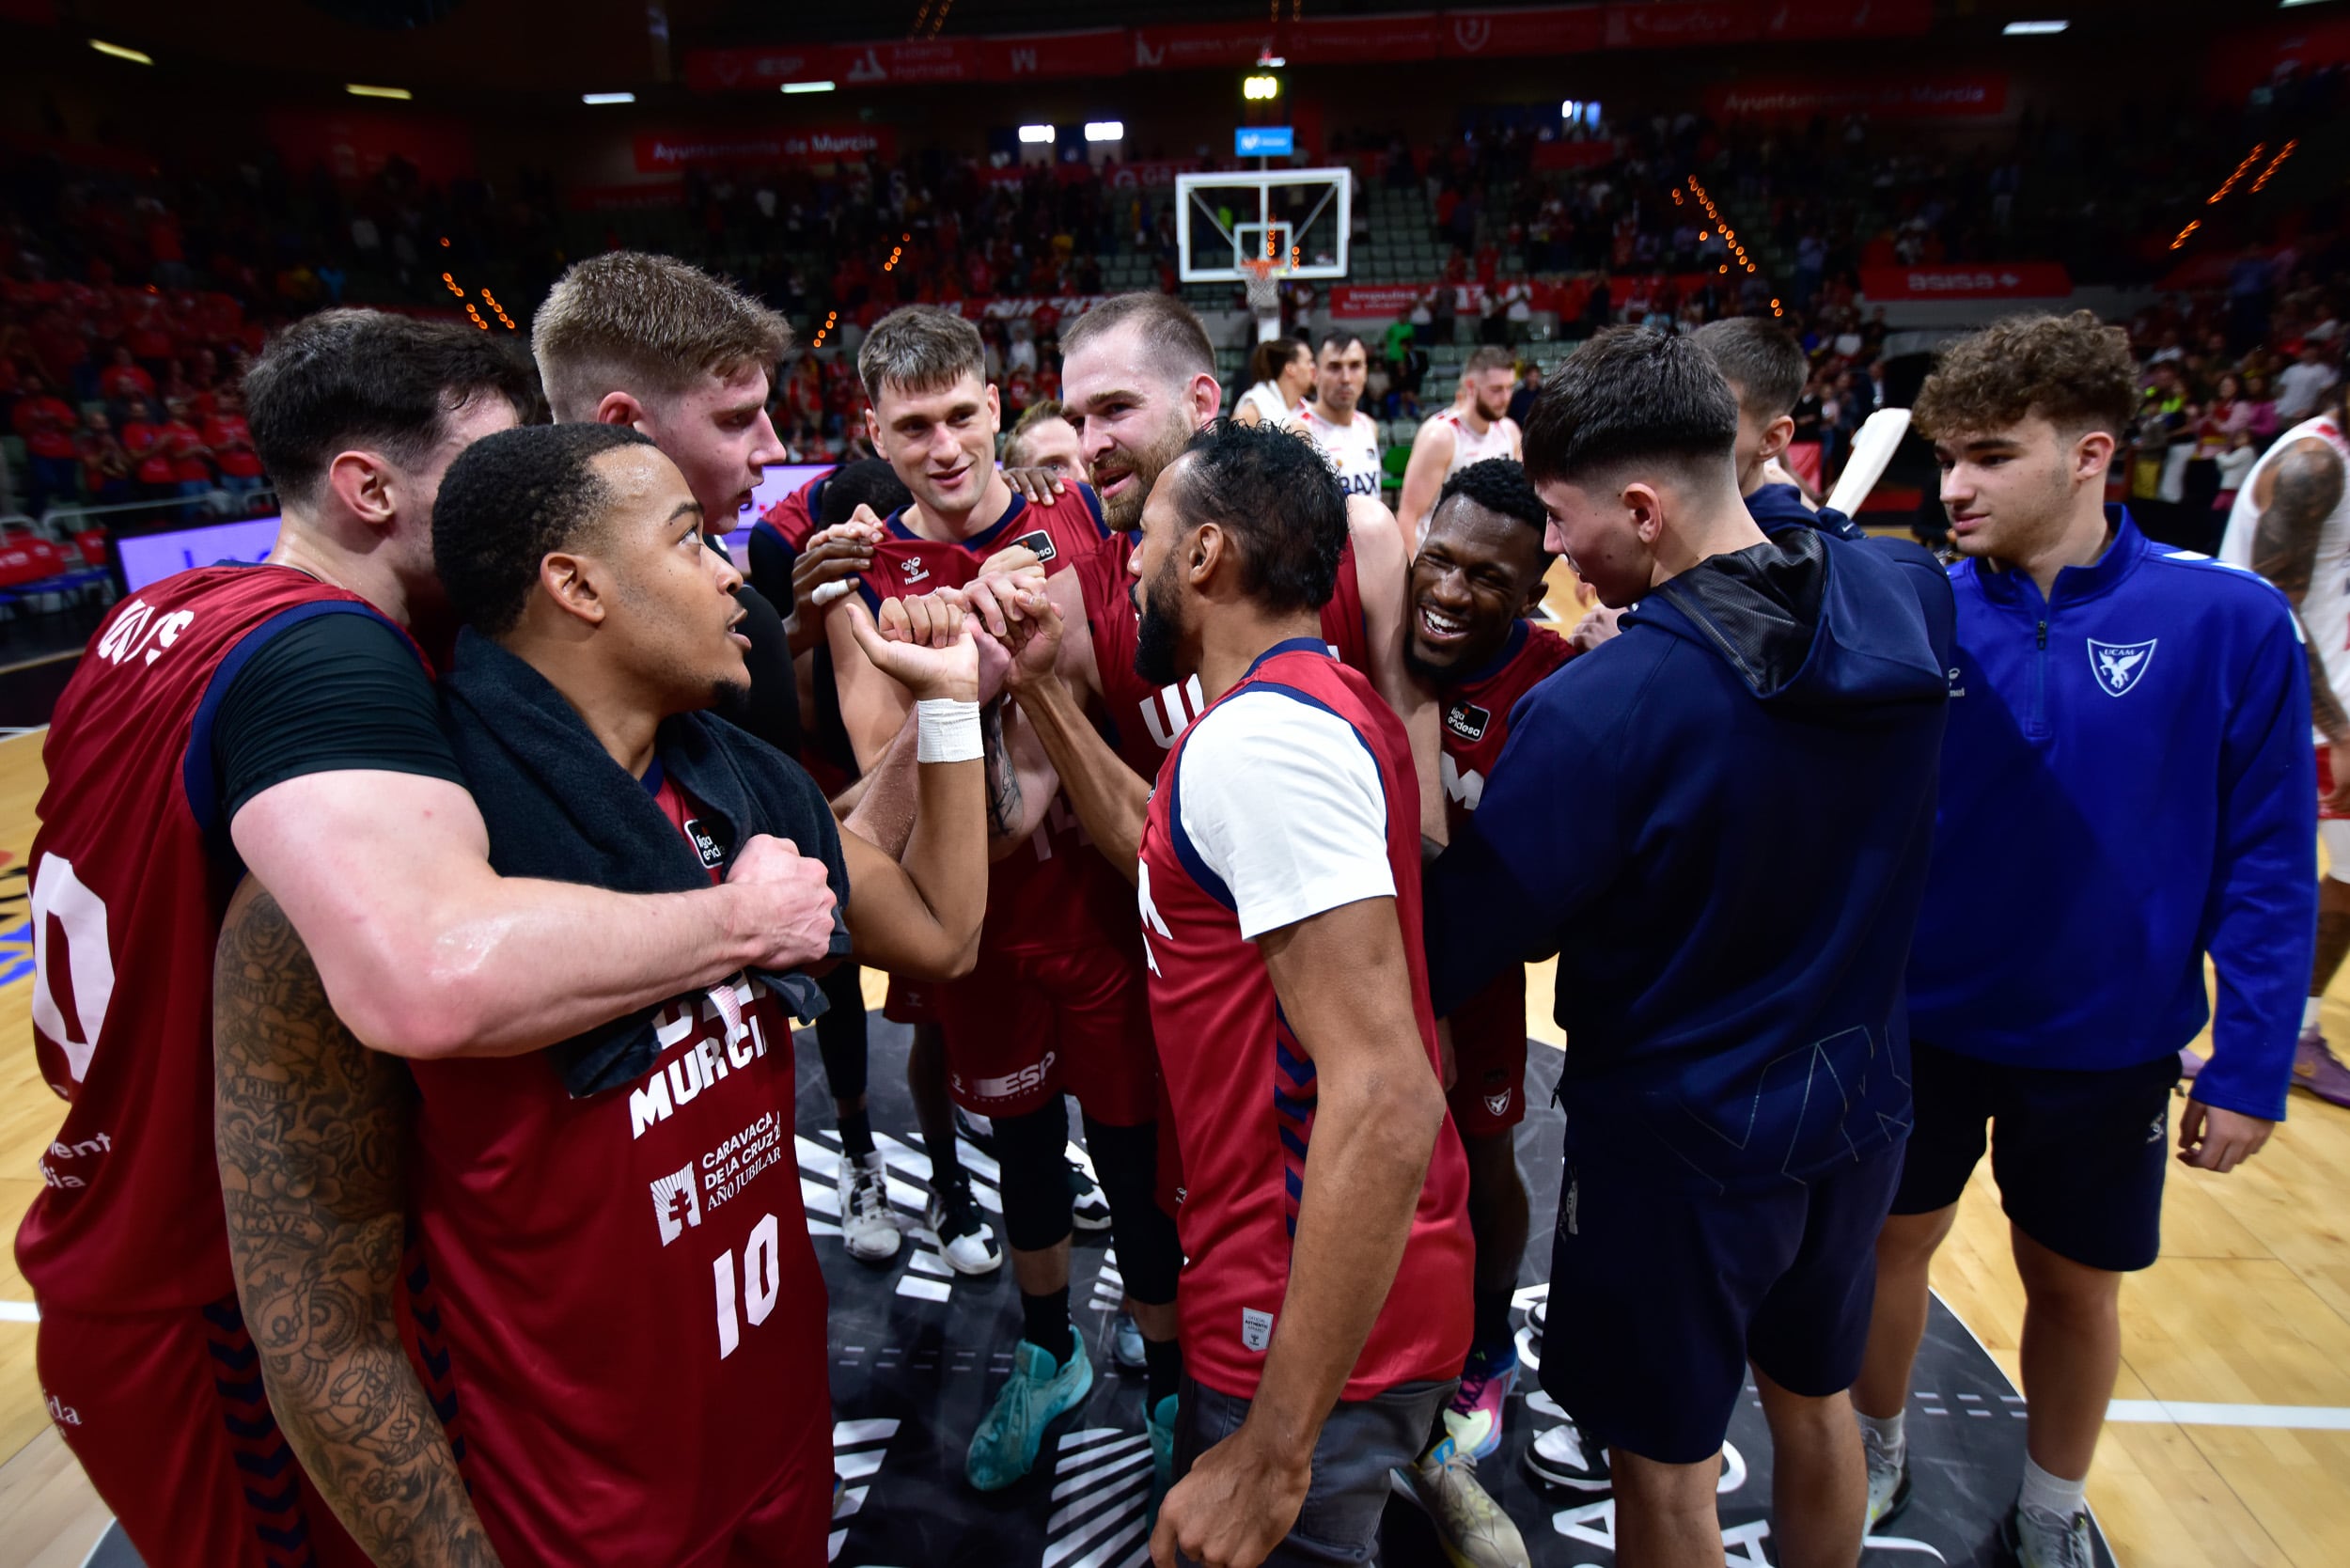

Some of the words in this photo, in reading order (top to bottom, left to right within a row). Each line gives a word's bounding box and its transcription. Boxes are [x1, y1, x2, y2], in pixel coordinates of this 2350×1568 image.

[1723, 90, 1871, 115] Ayuntamiento
[1881, 86, 1904, 103] de
[1912, 83, 1986, 103] Murcia
[652, 141, 780, 163] Ayuntamiento
[784, 135, 808, 155] de
[810, 132, 877, 153] Murcia
[903, 569, 931, 586] hummel
[2104, 648, 2136, 657] UCAM
[1448, 715, 1481, 737] endesa
[1450, 707, 1465, 720] liga
[696, 834, 713, 850] liga
[629, 1014, 767, 1140] MURCI
[702, 1111, 774, 1168] CARAVACA
[704, 1167, 726, 1191] DE
[726, 1156, 741, 1178] LA
[742, 1132, 774, 1165] CRUZ
[707, 1182, 734, 1211] AÑO
[734, 1146, 781, 1195] JUBILAR
[712, 1213, 780, 1361] 10
